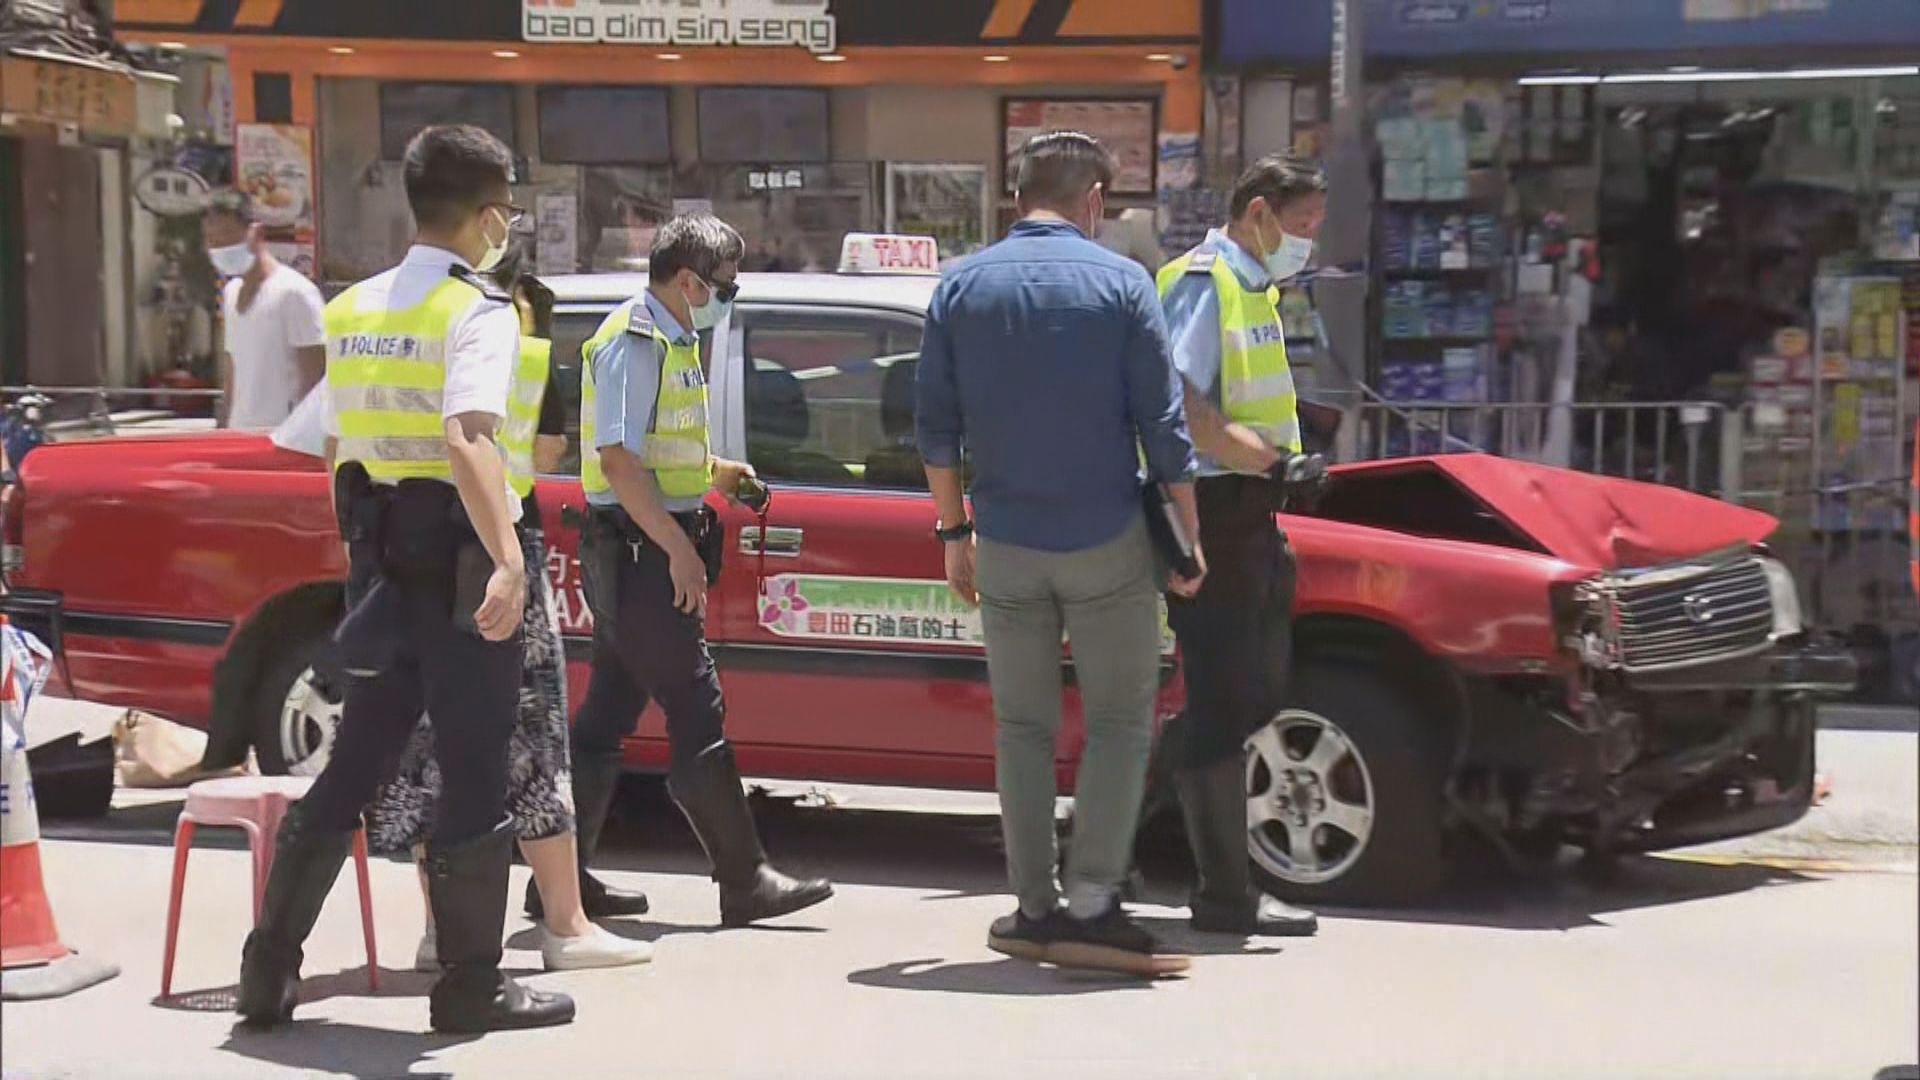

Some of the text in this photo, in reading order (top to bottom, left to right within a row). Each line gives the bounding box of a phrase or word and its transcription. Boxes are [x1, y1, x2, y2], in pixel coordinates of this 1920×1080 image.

[526, 11, 831, 48] bao dim sin seng
[873, 238, 931, 269] TAXI
[351, 335, 397, 356] POLICE
